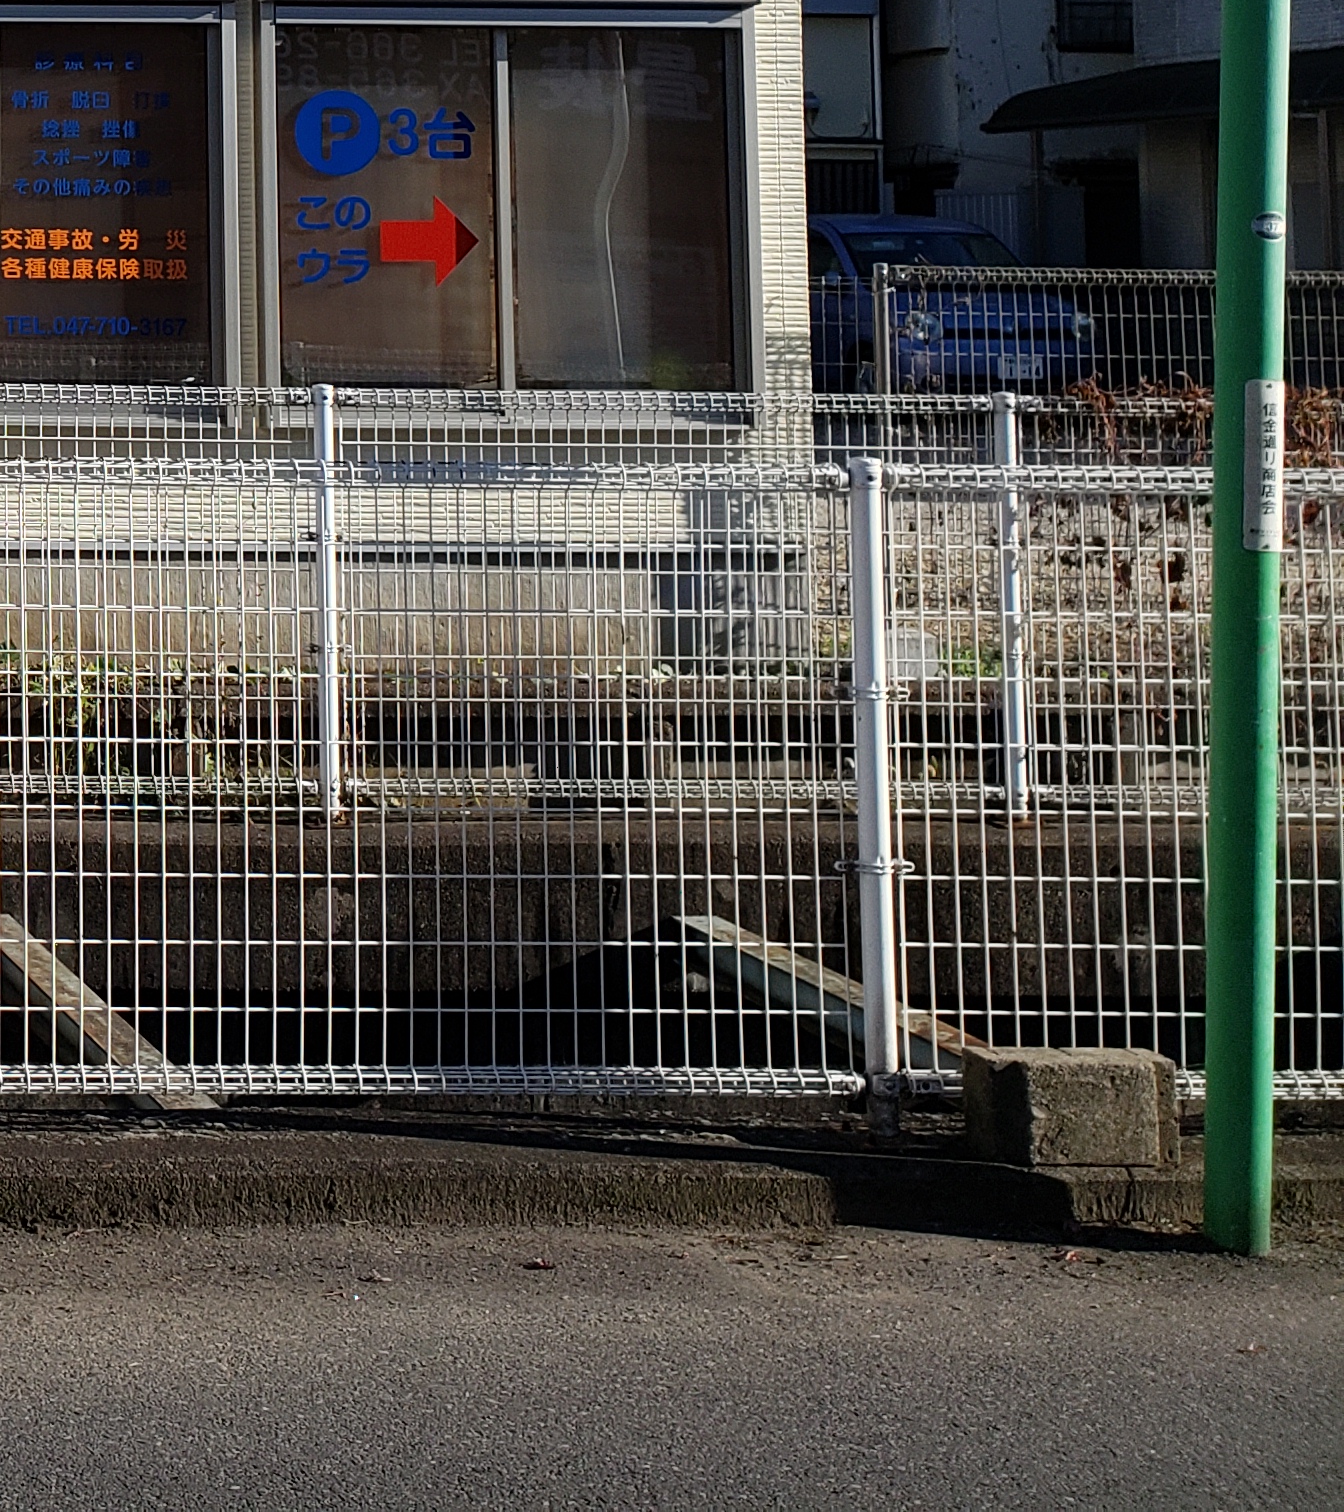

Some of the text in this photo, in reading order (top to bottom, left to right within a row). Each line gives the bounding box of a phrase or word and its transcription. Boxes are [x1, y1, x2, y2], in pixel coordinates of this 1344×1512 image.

[11, 90, 49, 109] 骨折
[72, 90, 110, 109] 脱臼
[321, 106, 476, 162] P 3台
[296, 195, 372, 231] この
[0, 228, 188, 251] 交通事故・労 災
[1, 257, 188, 280] 各種健康保険取扱
[297, 248, 371, 285] ウラ
[1261, 402, 1278, 516] 信金通り商店会
